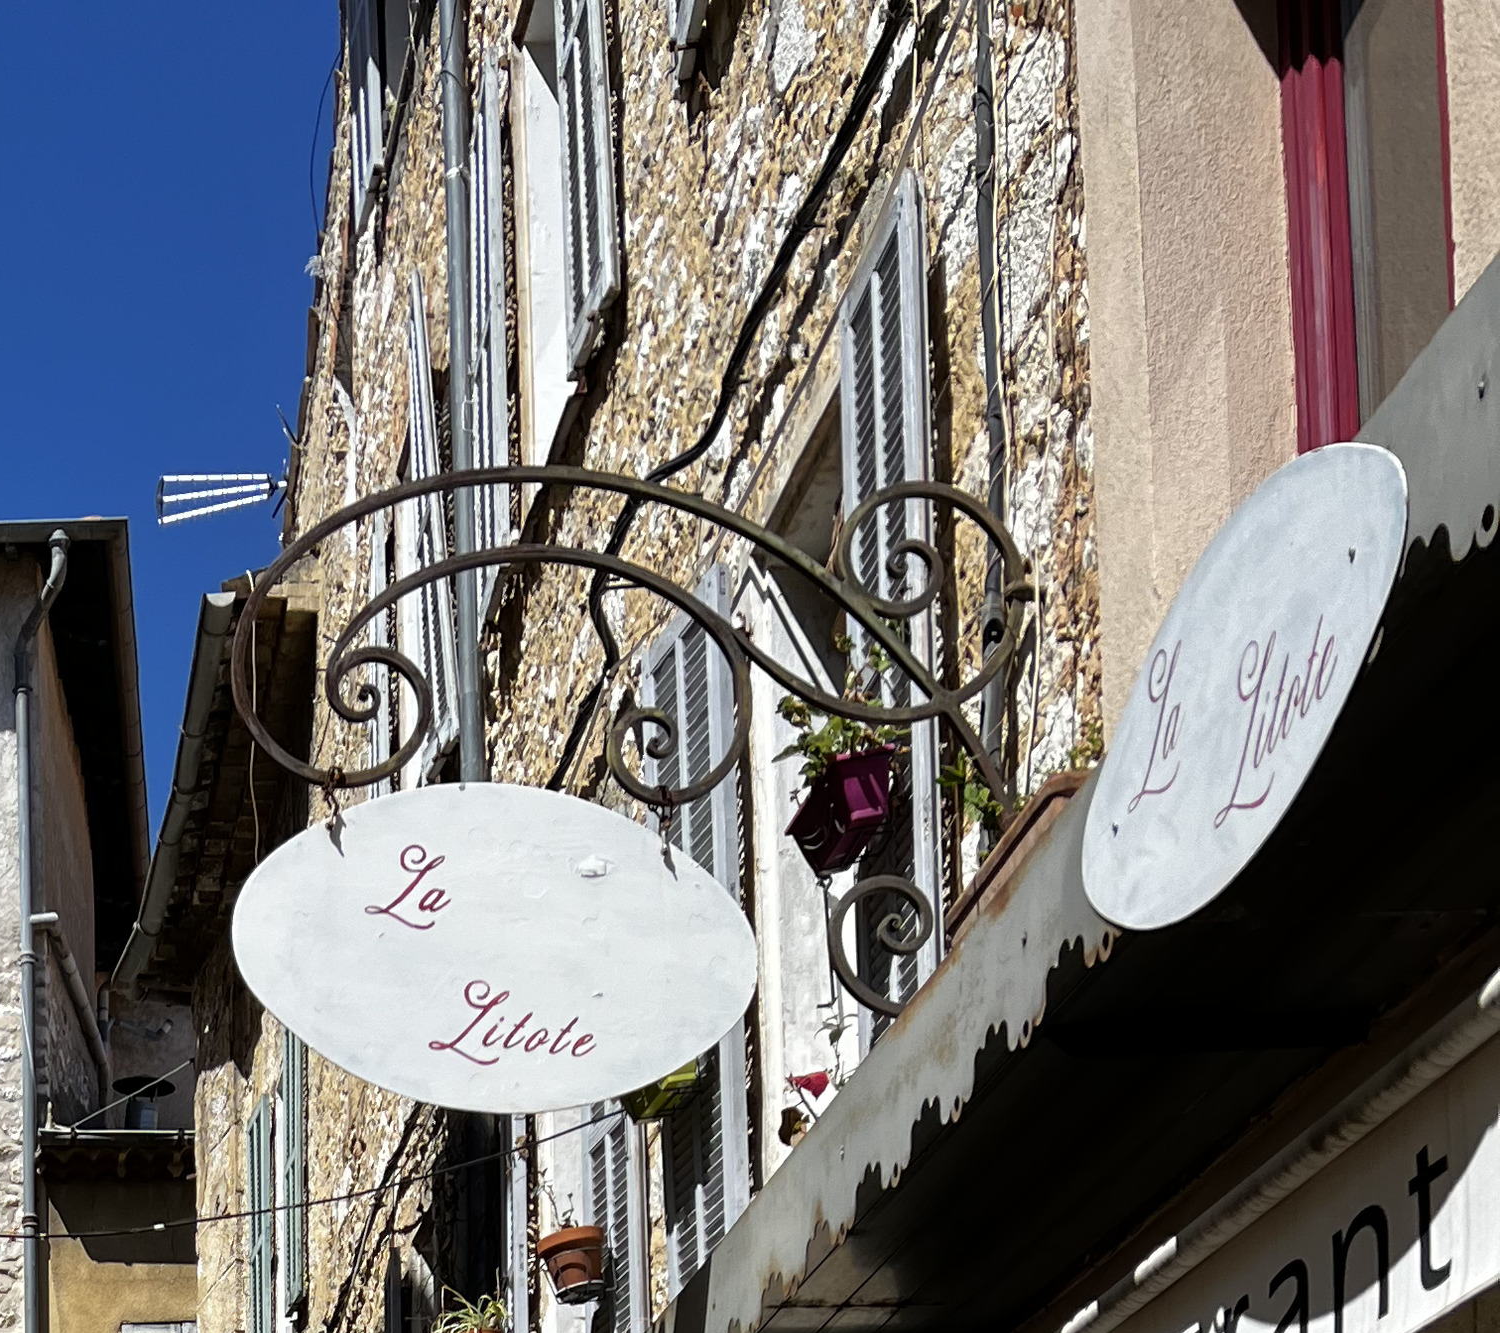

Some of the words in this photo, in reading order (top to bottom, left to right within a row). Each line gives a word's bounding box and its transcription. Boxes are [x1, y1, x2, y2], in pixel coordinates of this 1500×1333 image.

[1128, 639, 1185, 814] La
[1214, 614, 1339, 830] Litote
[365, 844, 452, 930] La
[428, 979, 598, 1066] Litote
